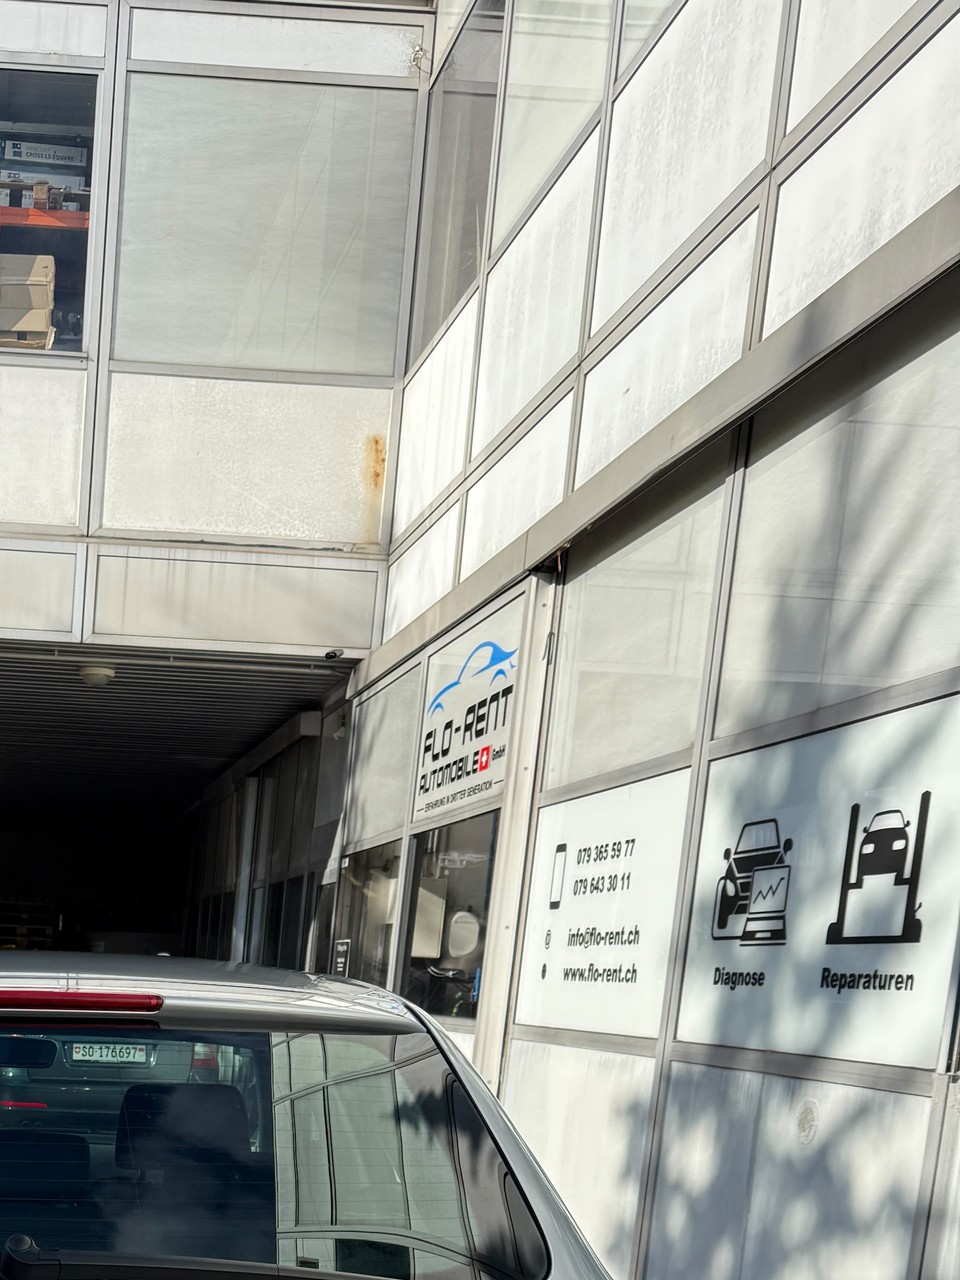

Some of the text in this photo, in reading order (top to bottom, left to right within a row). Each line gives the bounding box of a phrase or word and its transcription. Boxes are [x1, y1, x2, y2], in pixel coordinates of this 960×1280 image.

[26, 151, 43, 159] CROSS
[52, 153, 74, 161] SQUARE
[422, 684, 514, 768] FLO-RENT
[419, 744, 506, 796] AUTOMOBILE GmbH
[467, 779, 493, 797] GENERATION
[577, 838, 636, 865] 079 365 59 77
[573, 872, 631, 896] 079 643 30 11
[567, 925, 640, 949] info@flo-rent.ch
[563, 963, 638, 983] www.flo-rent.ch
[713, 967, 765, 991] Diagnose
[820, 967, 915, 994] Reparaturen
